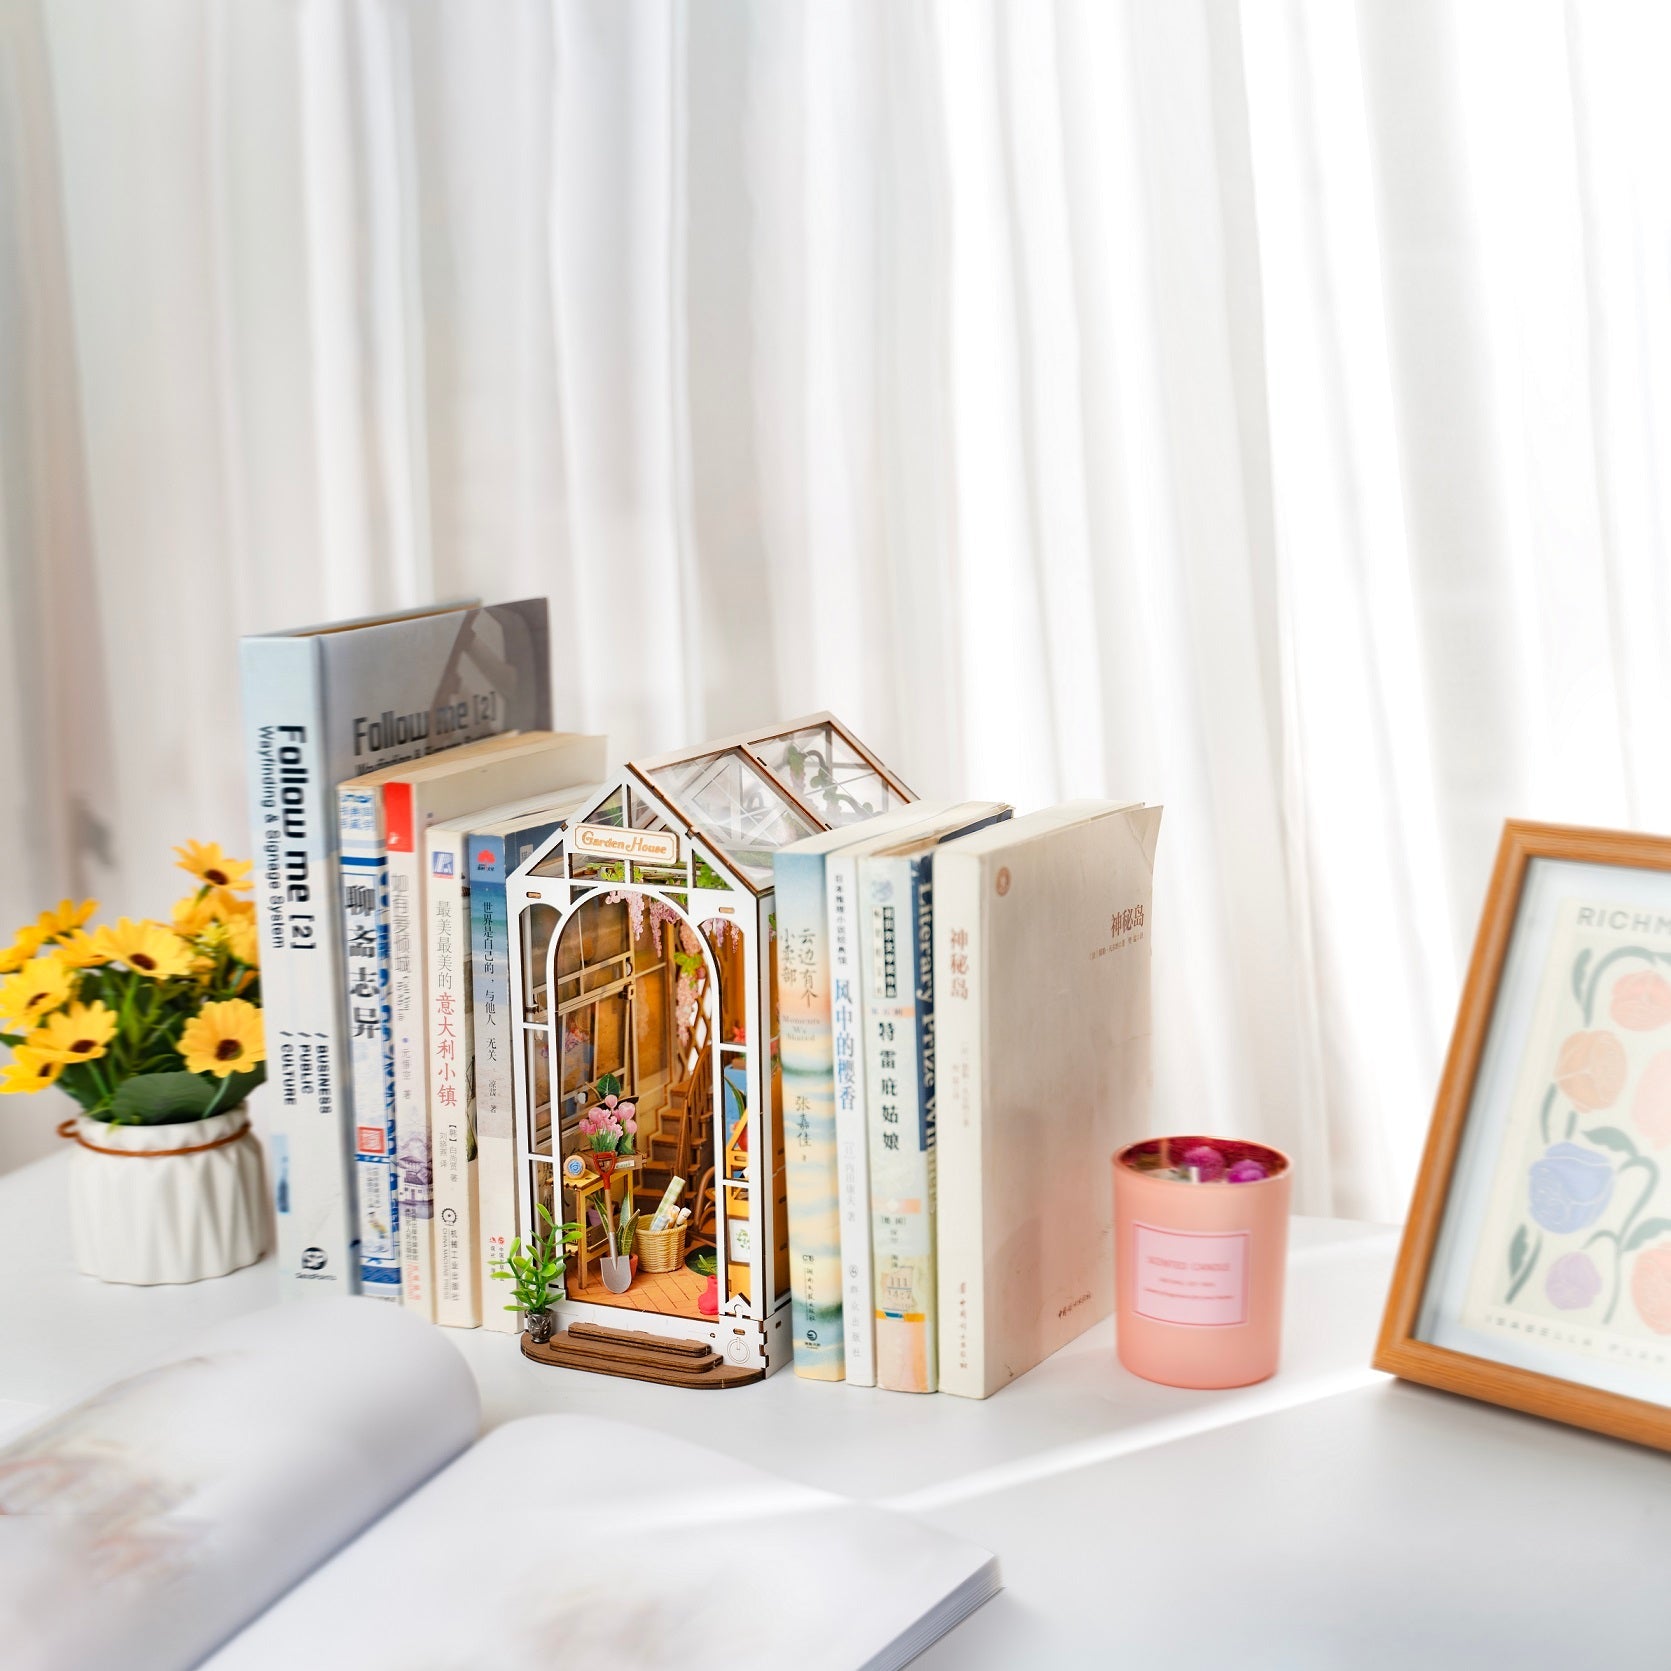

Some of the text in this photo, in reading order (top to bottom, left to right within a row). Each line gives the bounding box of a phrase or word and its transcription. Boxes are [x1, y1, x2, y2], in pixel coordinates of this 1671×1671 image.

[352, 710, 430, 756] Follow
[435, 702, 469, 735] me
[473, 691, 497, 725] [2]
[256, 725, 279, 808] Wayfinding
[263, 829, 281, 890] Signage
[277, 725, 317, 950] Follow me [2]
[582, 830, 667, 854] Garden House
[265, 895, 286, 949] System
[915, 882, 933, 1003] Literary
[1111, 904, 1144, 939] 神秘岛
[345, 884, 381, 1039] 聊斋志异
[781, 928, 797, 986] 小卖部
[798, 928, 817, 1008] 云边有个
[950, 927, 969, 1000] 神秘岛
[435, 900, 457, 1108] 最美最美的意大利小镇
[281, 1043, 297, 1106] CULTURE
[299, 1044, 314, 1095] PUBLIC
[316, 1045, 332, 1114] BUSINESS
[878, 1021, 900, 1151] 特雷庇姑娘
